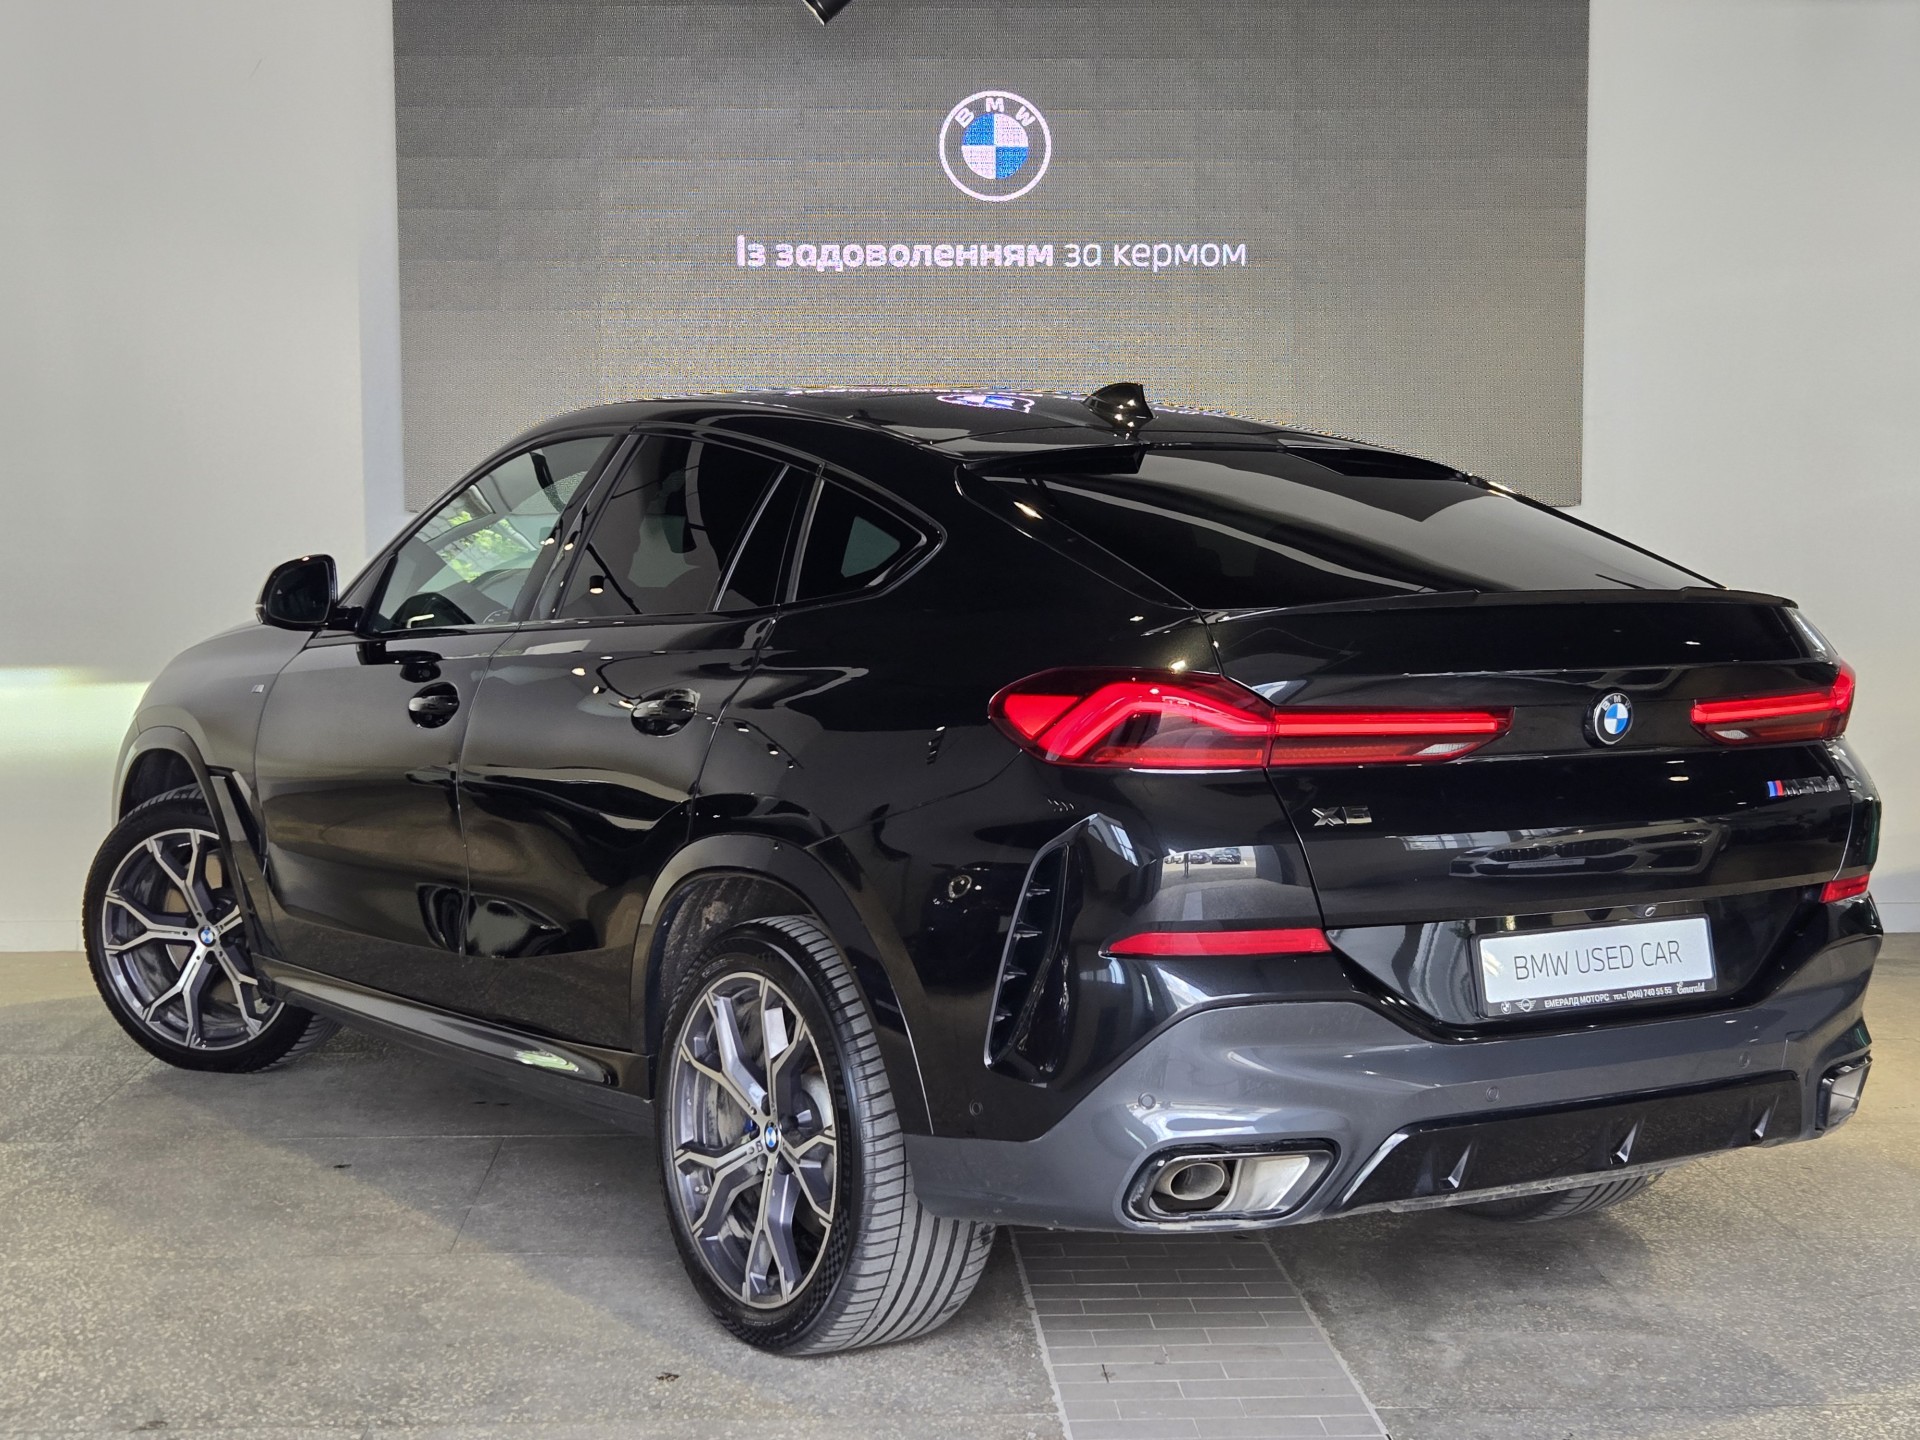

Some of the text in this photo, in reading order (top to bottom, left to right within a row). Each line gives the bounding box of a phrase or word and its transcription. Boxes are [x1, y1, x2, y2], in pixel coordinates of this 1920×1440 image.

[955, 98, 1036, 128] BMW
[736, 234, 1246, 272] Із задоволенням за кермом
[1601, 694, 1631, 711] BMW
[1514, 940, 1683, 980] BMW USED CAR
[1544, 996, 1580, 1008] ЕМЕРАЛД
[1580, 993, 1610, 1004] МОТОРС
